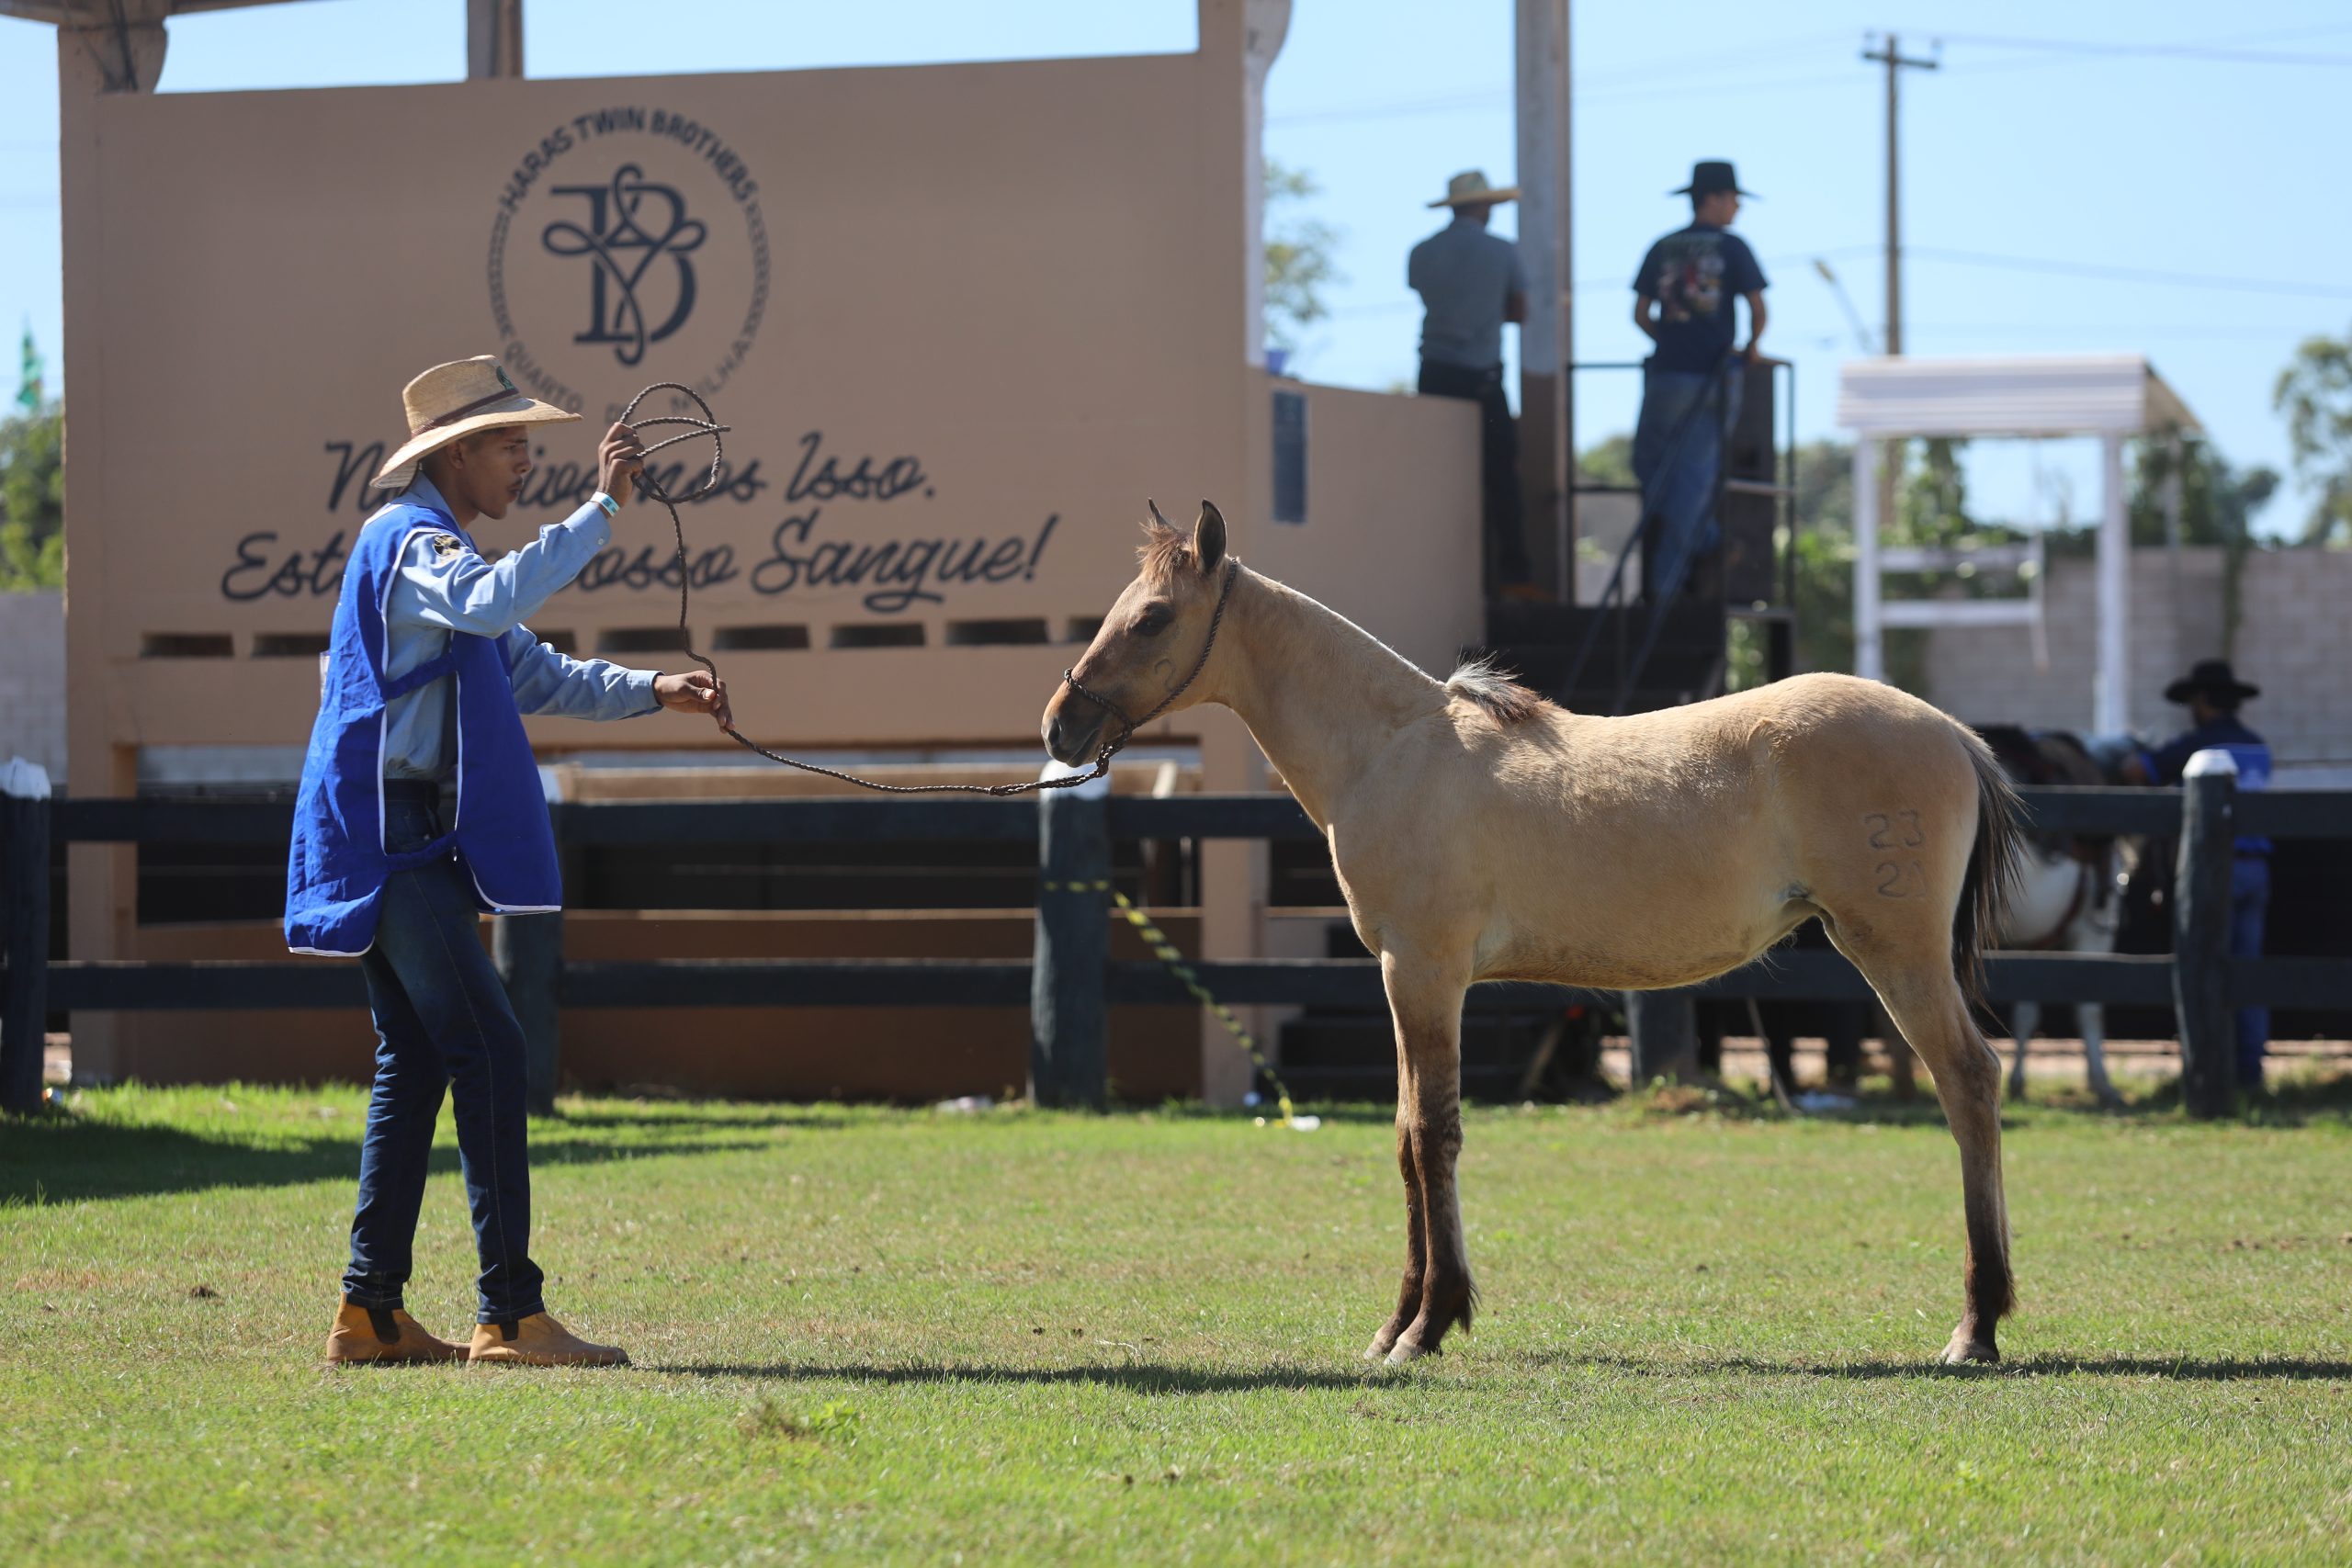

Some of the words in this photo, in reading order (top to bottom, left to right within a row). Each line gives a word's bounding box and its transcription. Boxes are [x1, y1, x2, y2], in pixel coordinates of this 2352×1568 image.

[500, 126, 573, 210] HARAS
[571, 107, 645, 142] TWIN
[651, 109, 759, 201] BROTHERS
[786, 431, 935, 502] Isso.
[221, 529, 345, 602] Est
[562, 544, 739, 592] osso
[751, 507, 1059, 614] Sangue!
[1865, 808, 1925, 849] 23
